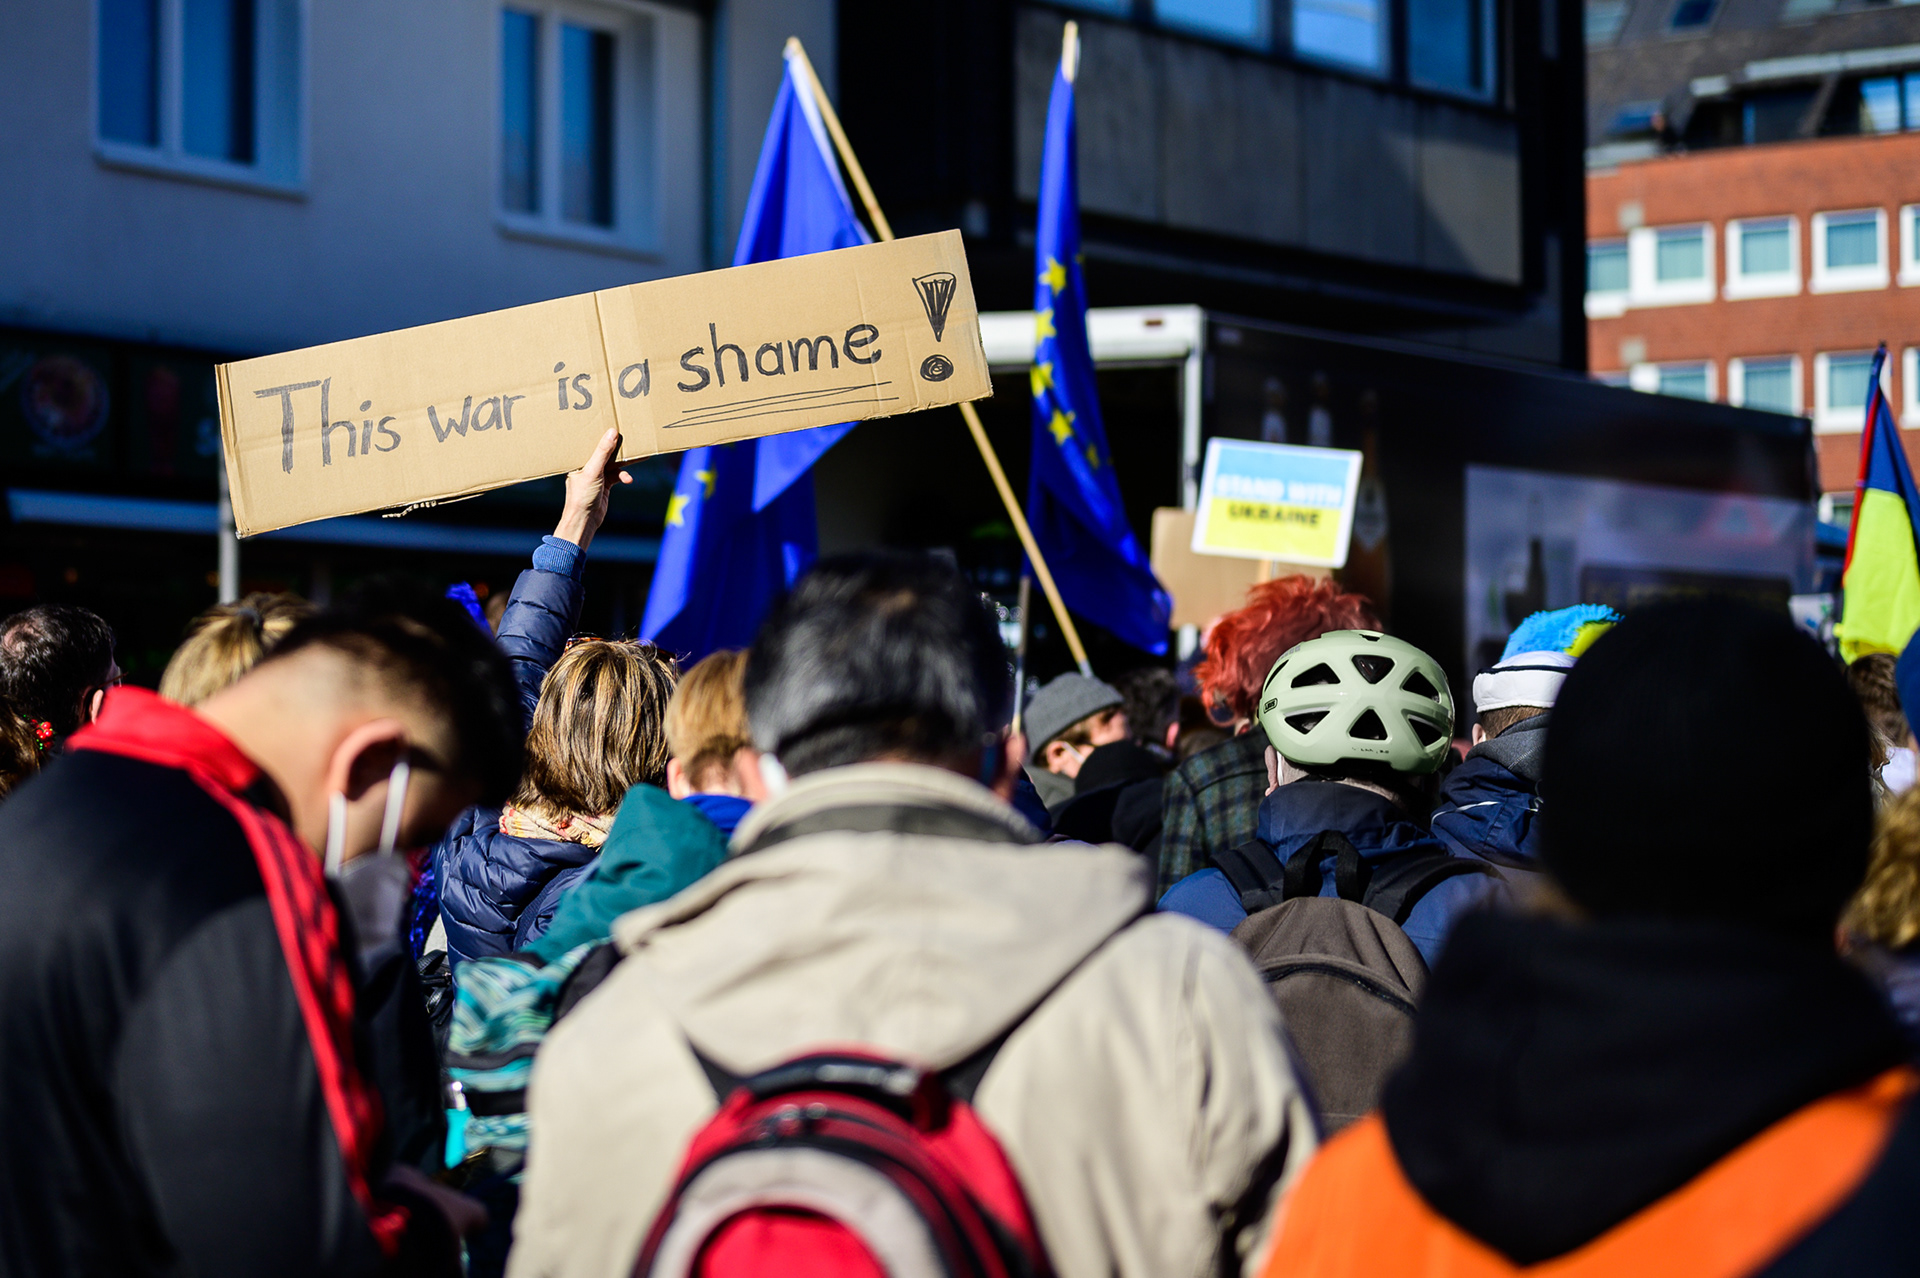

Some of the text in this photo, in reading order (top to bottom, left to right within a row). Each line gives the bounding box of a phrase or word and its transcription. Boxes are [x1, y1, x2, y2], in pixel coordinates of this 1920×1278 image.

[253, 376, 401, 474] This
[427, 394, 526, 443] war
[553, 361, 593, 411] is
[618, 358, 650, 399] a
[1215, 474, 1343, 507] STAND WITH
[1228, 503, 1320, 527] UKRAINE
